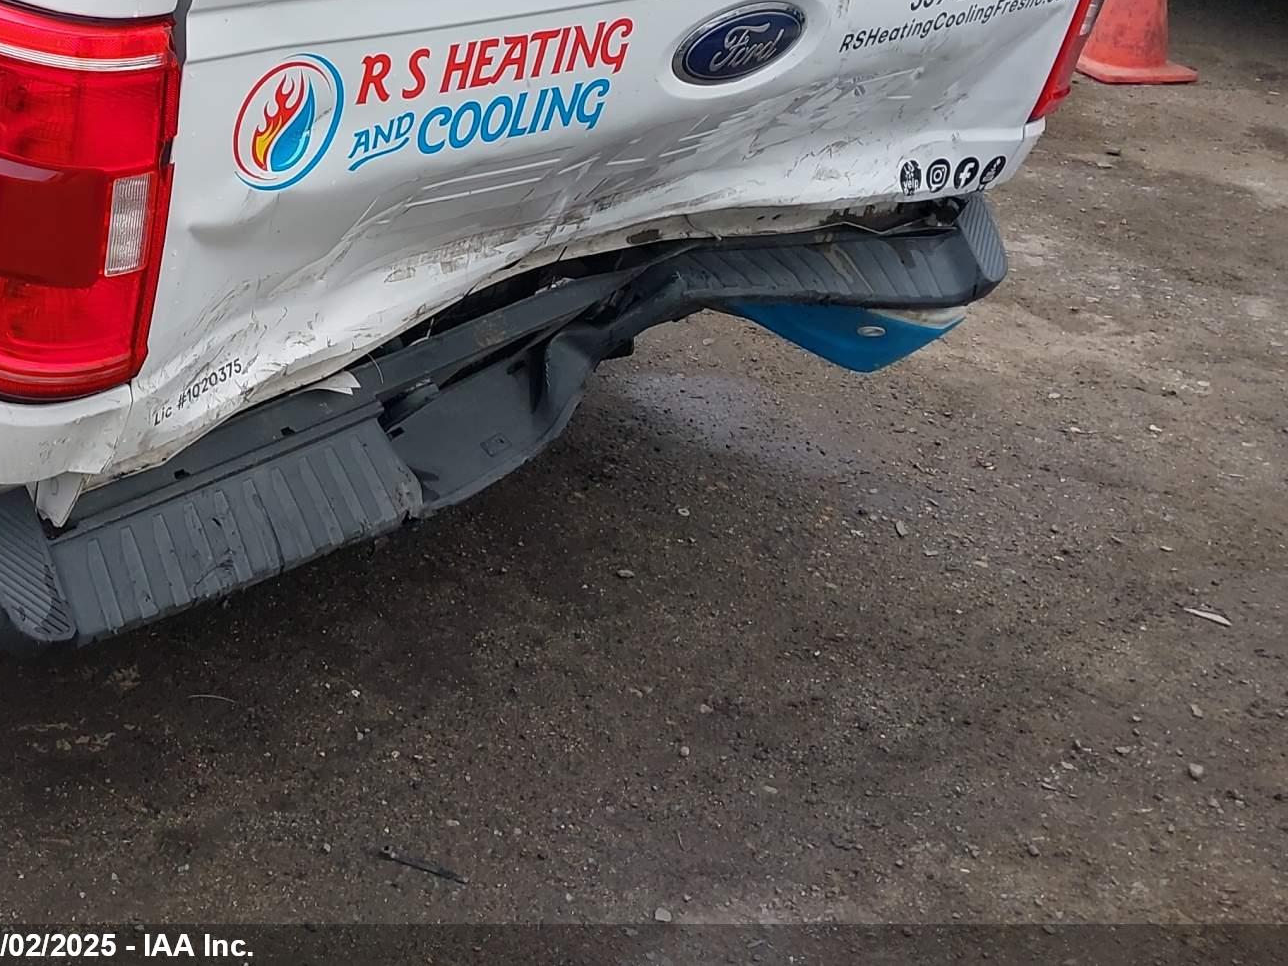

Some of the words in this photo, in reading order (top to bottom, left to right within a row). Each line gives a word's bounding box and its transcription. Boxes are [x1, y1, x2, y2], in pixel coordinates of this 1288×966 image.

[355, 53, 392, 105] R
[402, 48, 431, 99] S
[439, 18, 633, 94] HEATING
[709, 22, 784, 72] Ford
[348, 112, 415, 160] AND
[417, 78, 610, 155] COOLING
[153, 406, 173, 426] Lic
[176, 358, 242, 409] #1020375
